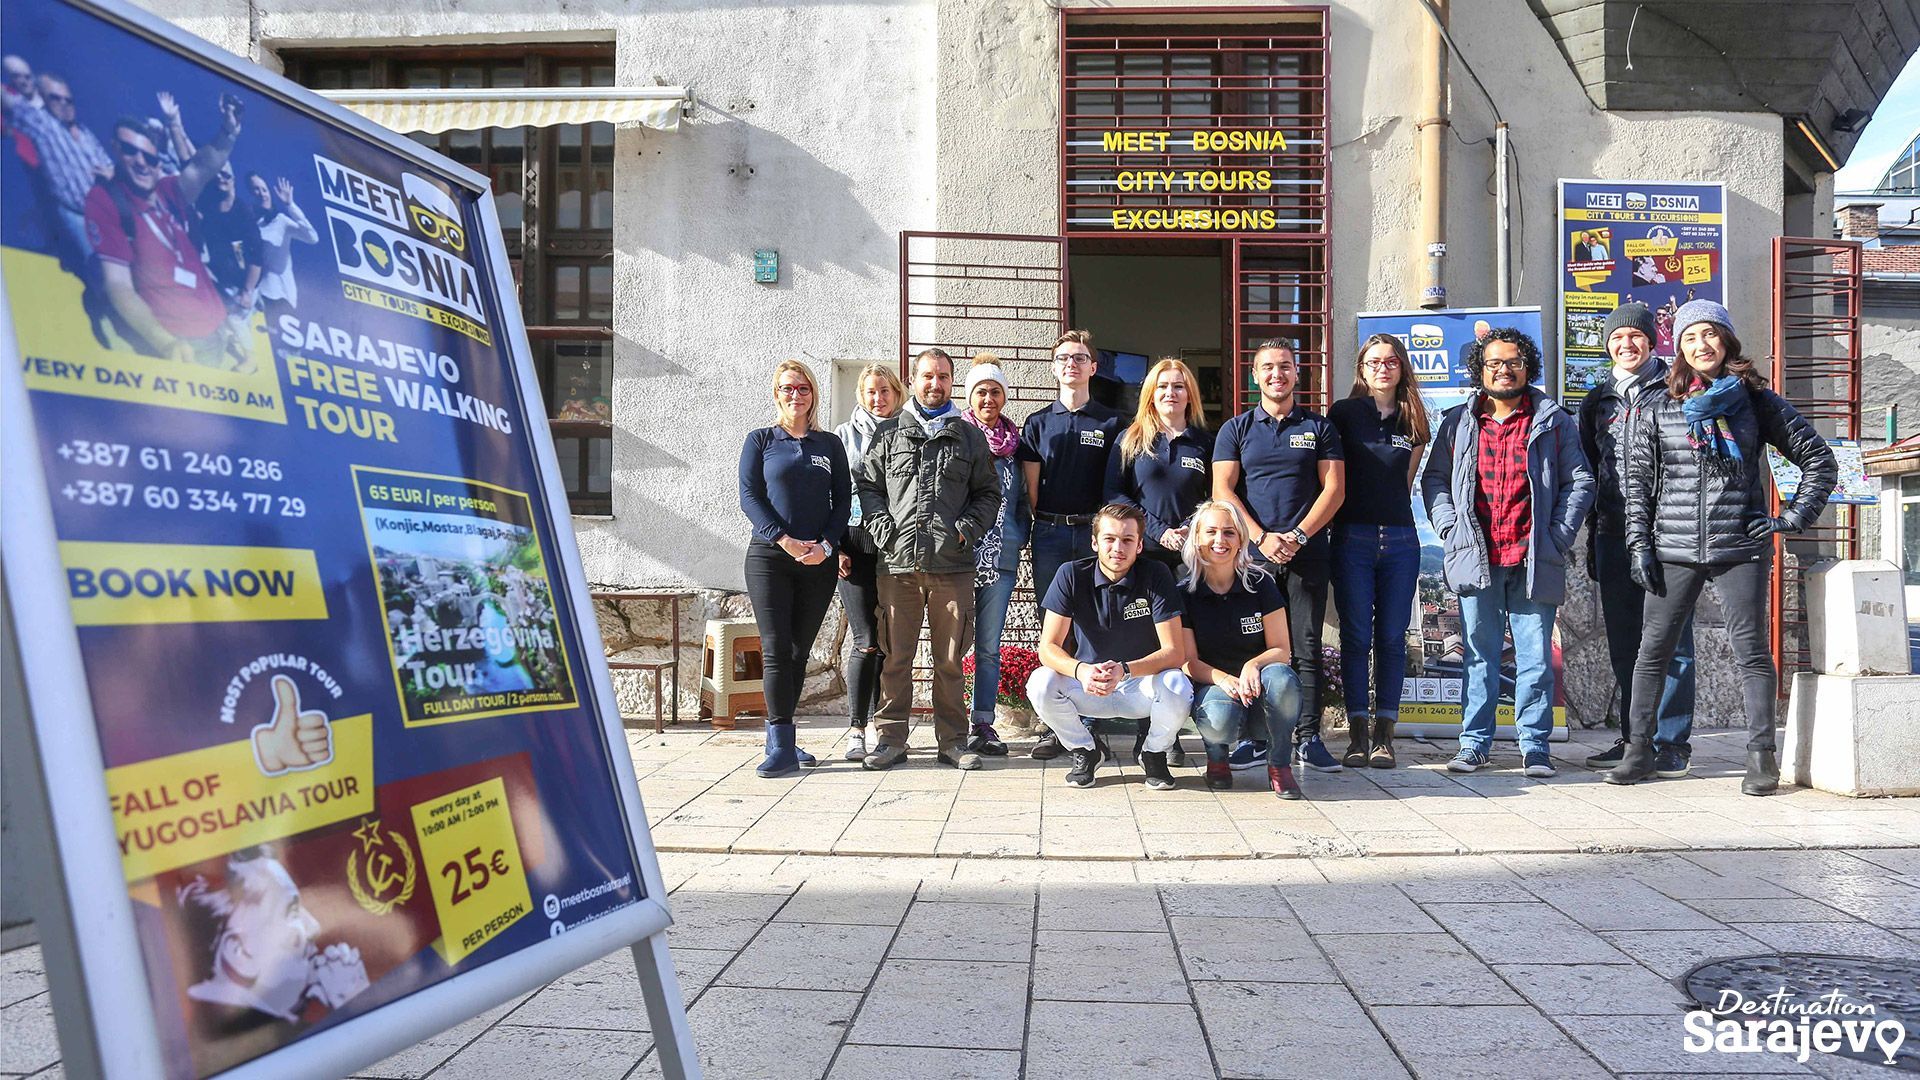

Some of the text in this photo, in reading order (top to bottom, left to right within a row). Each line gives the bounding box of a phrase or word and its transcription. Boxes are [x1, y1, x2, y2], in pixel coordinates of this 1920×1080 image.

[1103, 130, 1287, 152] MEET BOSNIA
[317, 160, 401, 222] MEET
[1117, 170, 1272, 191] CITY TOURS
[1112, 208, 1276, 230] EXCURSIONS
[1587, 194, 1698, 209] MEET BOSNIA
[1587, 210, 1605, 219] CITY
[1609, 211, 1635, 220] TOURS
[1650, 212, 1699, 222] EXCURSIONS
[330, 215, 483, 316] BOSNIA
[343, 283, 490, 343] CITY TOURS & EXCURSIONS
[279, 314, 460, 384] SARAJEVO
[1410, 353, 1447, 370] NIA
[95, 367, 143, 389] DAY
[153, 376, 179, 394] AT
[187, 381, 239, 404] 10:30
[246, 391, 274, 410] AM
[287, 355, 512, 435] FREE WALKING
[296, 396, 399, 443] TOUR
[57, 440, 283, 482] +387 61 240 286
[62, 480, 306, 517] +387 60 334 77 29
[369, 484, 498, 513] 65 EUR / per person
[66, 567, 294, 599] BOOK NOW
[398, 624, 554, 656] Herzegovina
[220, 653, 343, 724] MOST POPULAR TOUR
[423, 700, 452, 715] FULL
[453, 697, 475, 712] DAY
[477, 694, 506, 708] TOUR
[512, 693, 518, 705] 2
[519, 692, 549, 706] persons
[549, 692, 564, 702] min.
[1399, 706, 1415, 714] 387
[1431, 707, 1446, 715] 240
[183, 774, 221, 800] OF
[430, 790, 482, 818] every day at
[118, 776, 359, 856] YUGOSLAVIA TOUR
[422, 821, 446, 837] 10:00
[447, 813, 461, 828] AM
[467, 802, 486, 819] 2:00
[486, 798, 499, 811] PM
[441, 846, 510, 907] 25€
[561, 872, 632, 909] meetbosniatravel
[462, 902, 524, 951] PER PERSON
